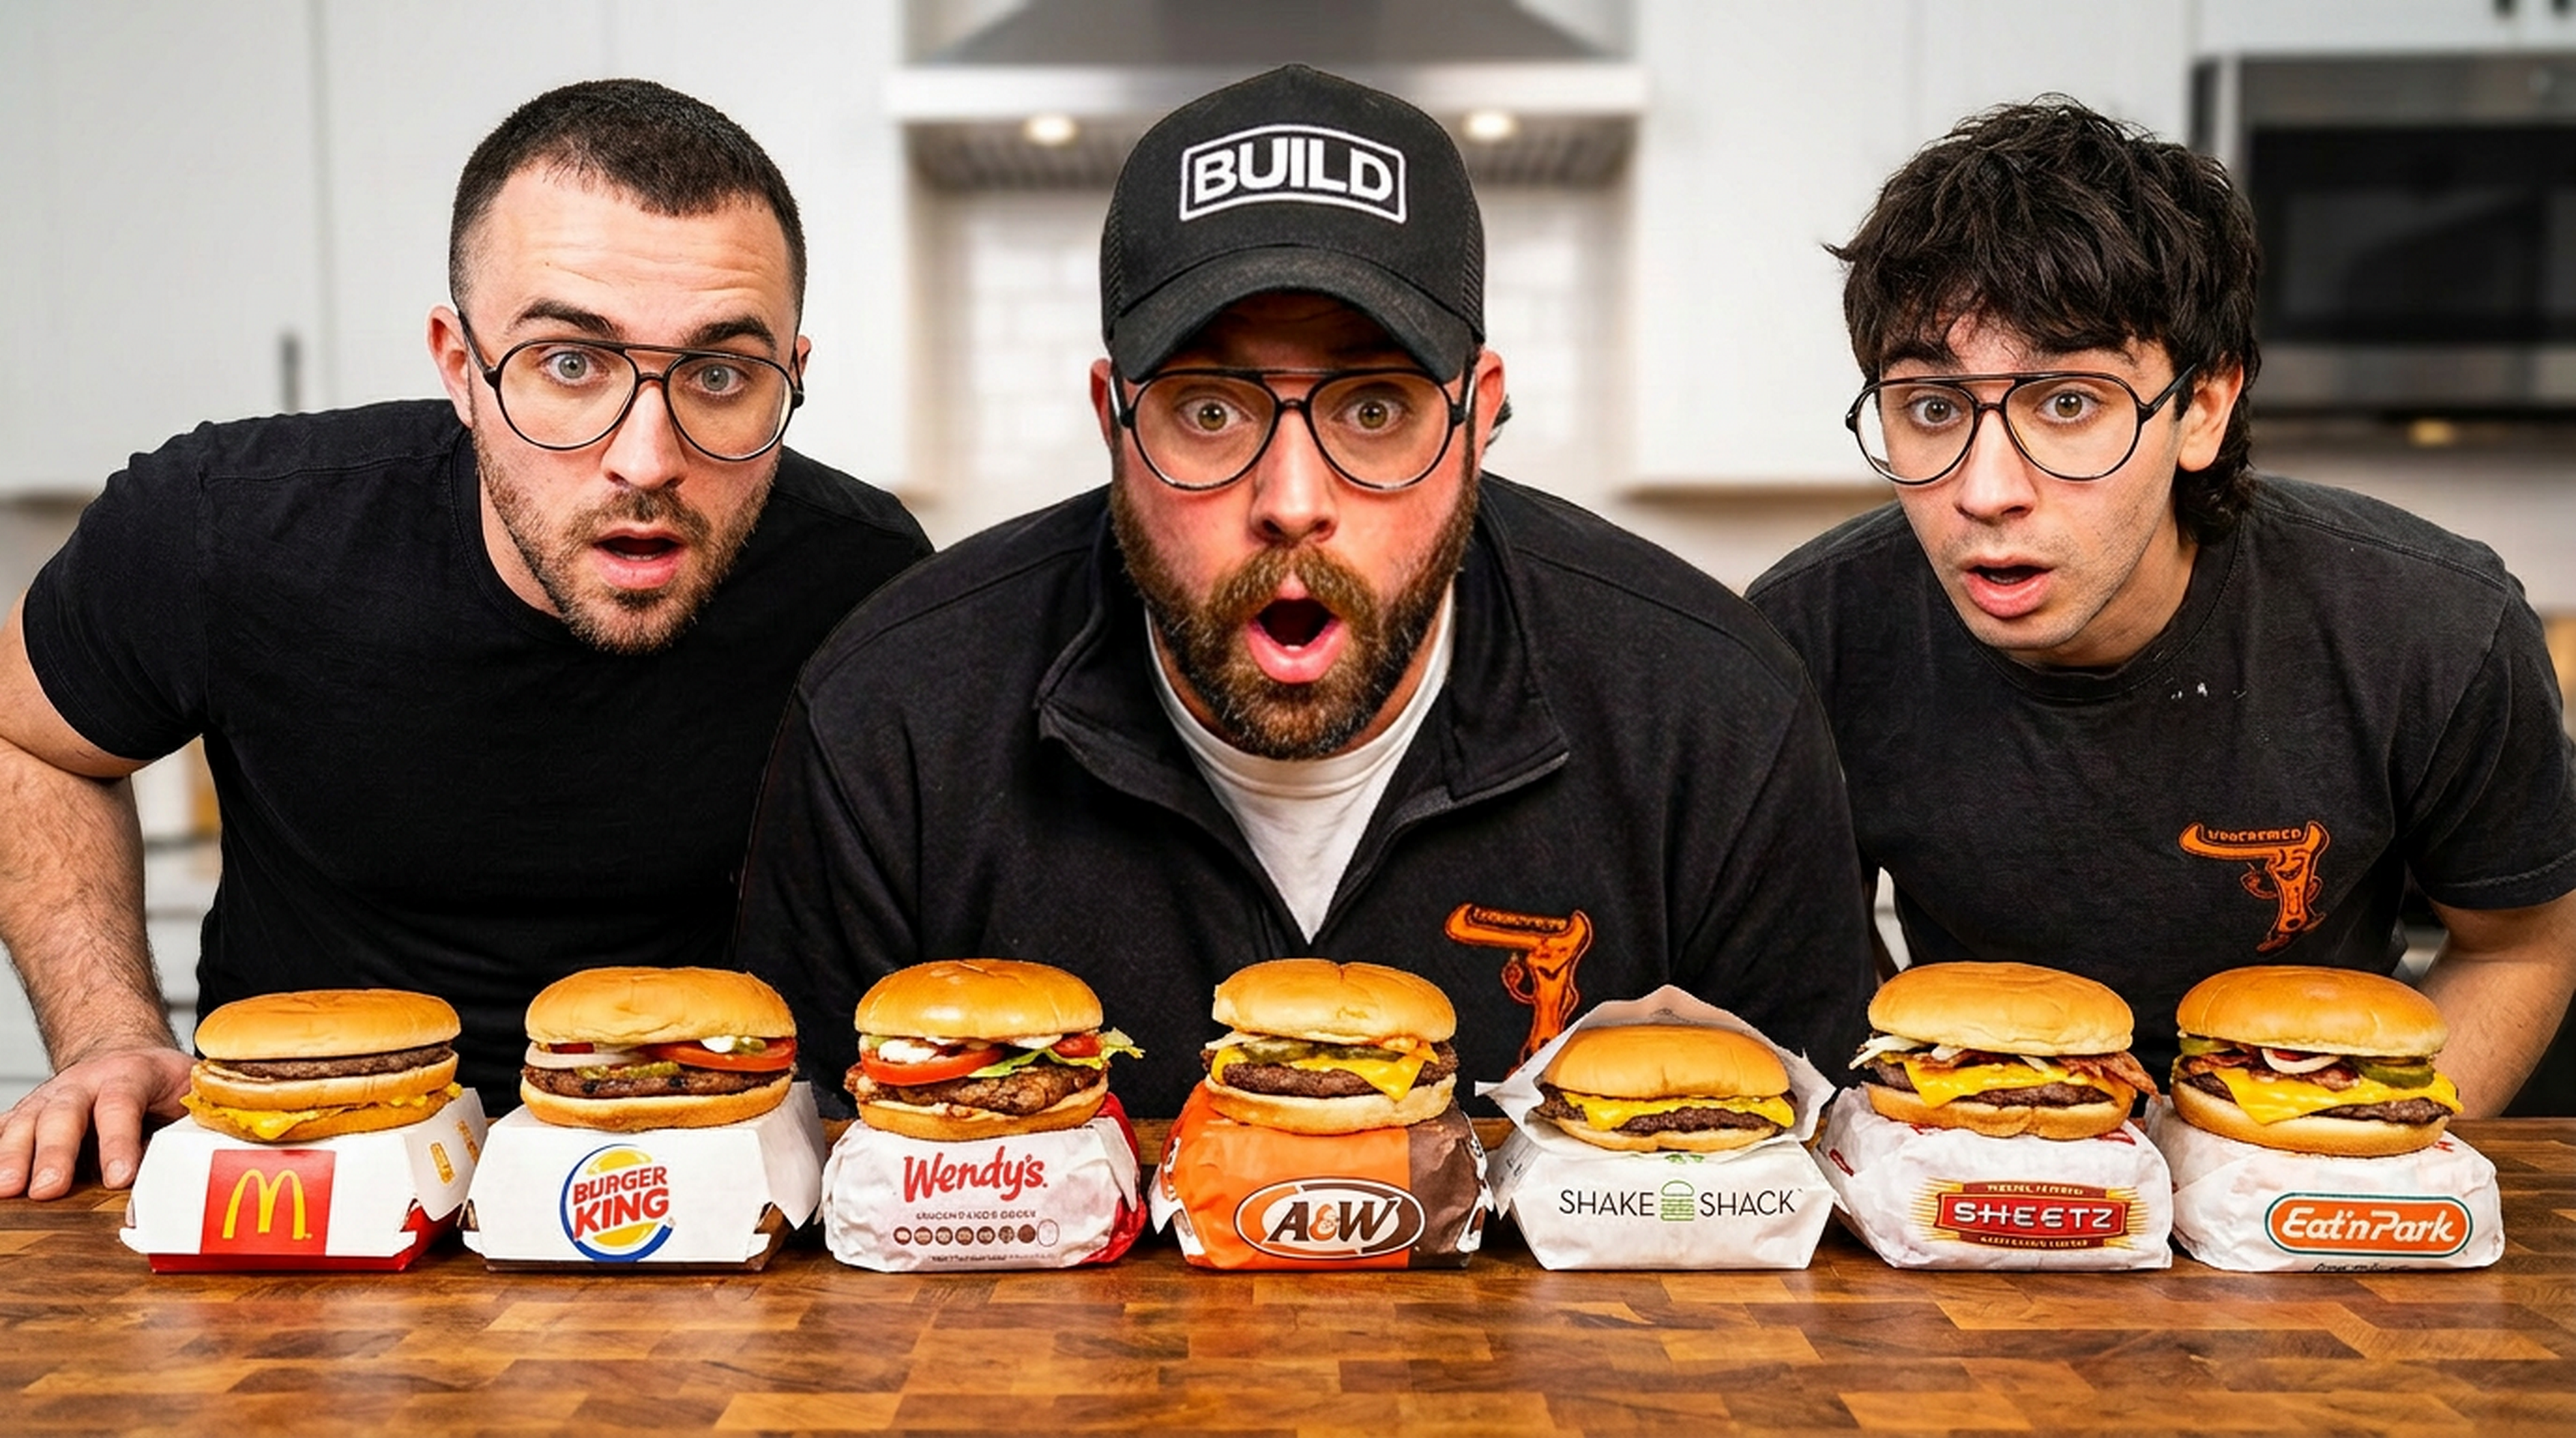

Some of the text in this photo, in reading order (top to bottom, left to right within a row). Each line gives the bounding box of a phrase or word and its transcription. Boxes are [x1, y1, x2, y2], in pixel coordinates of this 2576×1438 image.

[1194, 137, 1393, 204] BUILD
[573, 1166, 667, 1206] BURGER
[904, 1146, 1044, 1203] Wendy's
[574, 1188, 669, 1238] KING
[1266, 1201, 1400, 1242] A&W
[1559, 1189, 1795, 1216] SHAKE SHACK
[1954, 1201, 2113, 1228] SHEETZ
